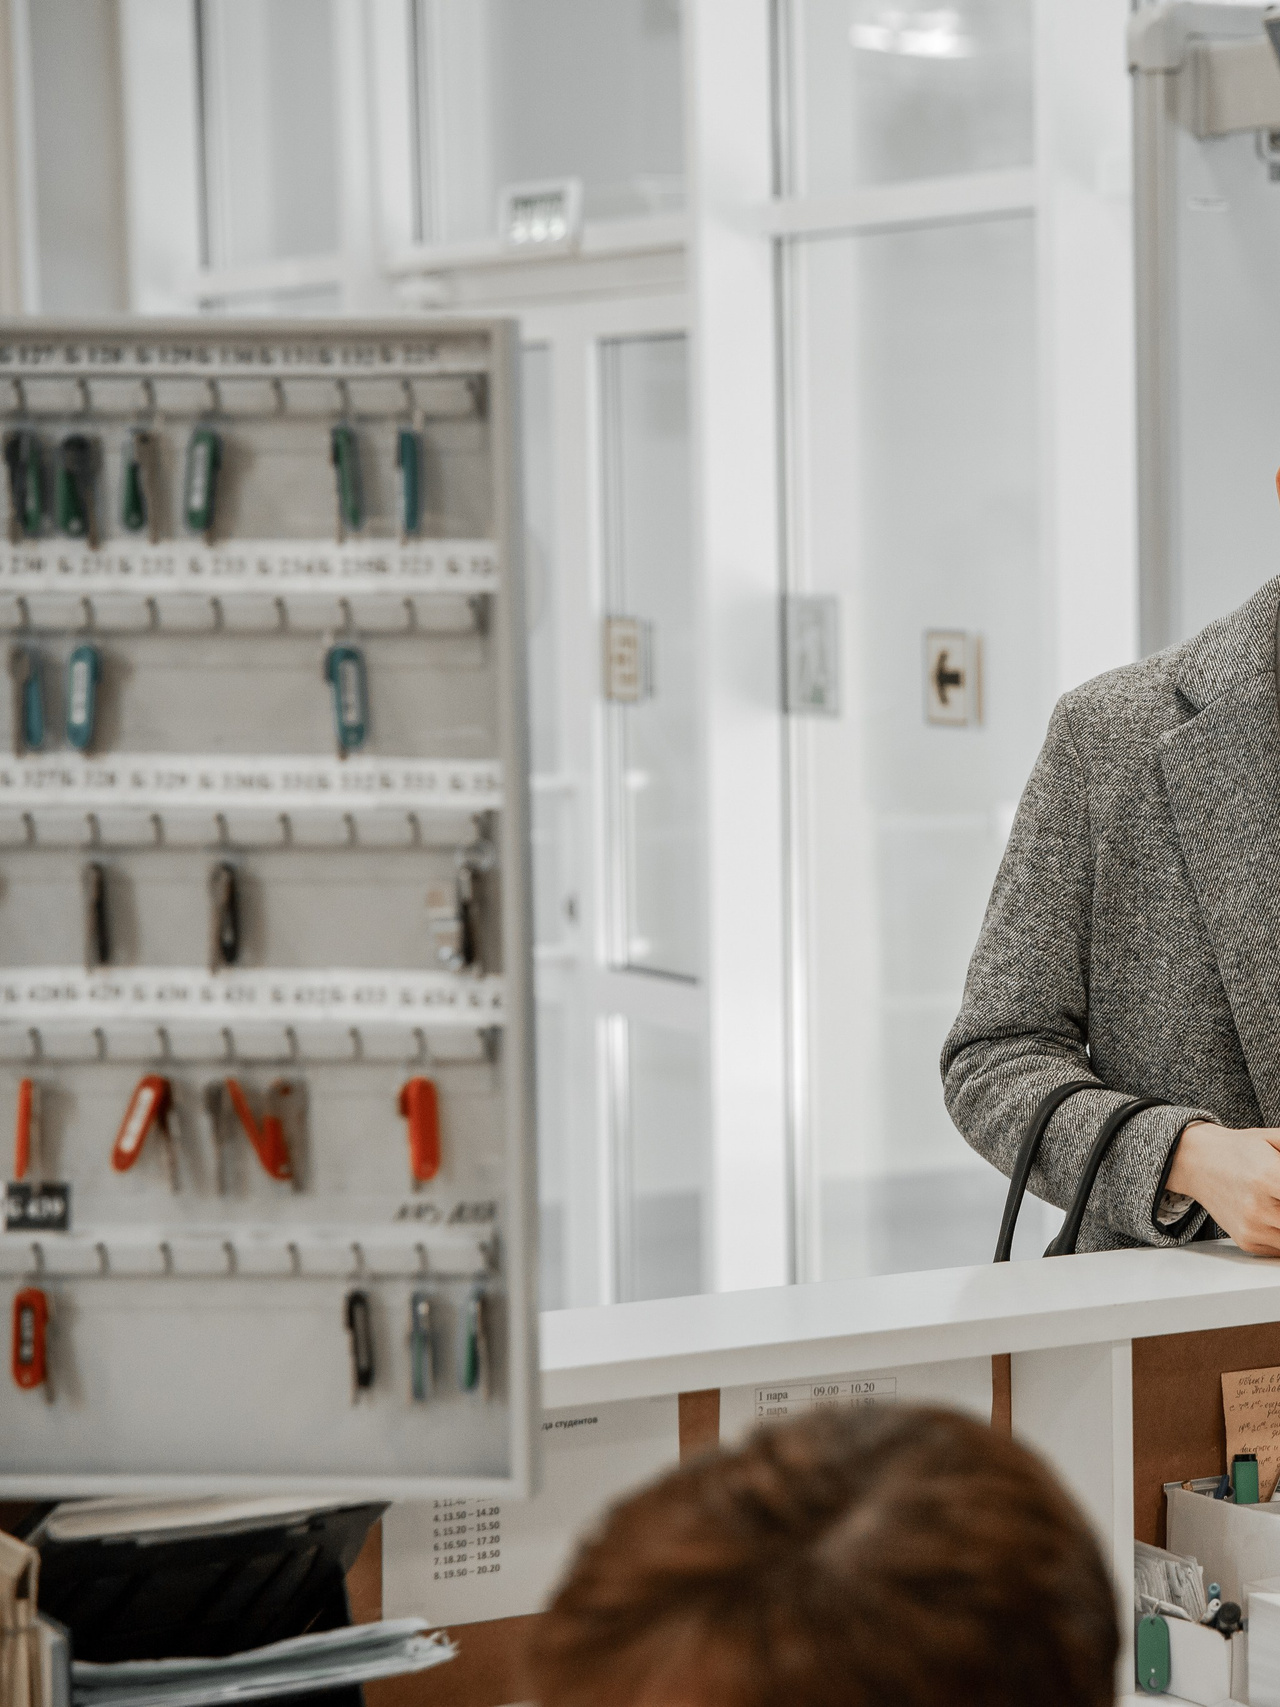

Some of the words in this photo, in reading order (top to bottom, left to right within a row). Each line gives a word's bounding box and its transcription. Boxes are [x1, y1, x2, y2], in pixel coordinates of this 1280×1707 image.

[759, 1391, 763, 1401] 1
[767, 1391, 788, 1402] пара
[813, 1385, 839, 1397] 09.00
[851, 1382, 875, 1394] 10.20
[758, 1406, 764, 1416] 2
[767, 1406, 788, 1417] пара
[555, 1417, 598, 1429] студентов
[443, 1510, 467, 1521] 13.50
[477, 1506, 500, 1518] 14.20
[443, 1525, 467, 1536] 15.20
[477, 1521, 500, 1532] 15.50
[443, 1539, 467, 1550] 16.50
[477, 1535, 500, 1546] 17.20
[443, 1554, 467, 1564] 18.20
[477, 1549, 500, 1560] 18.50
[443, 1568, 467, 1579] 19.50
[477, 1564, 500, 1575] 20.20
